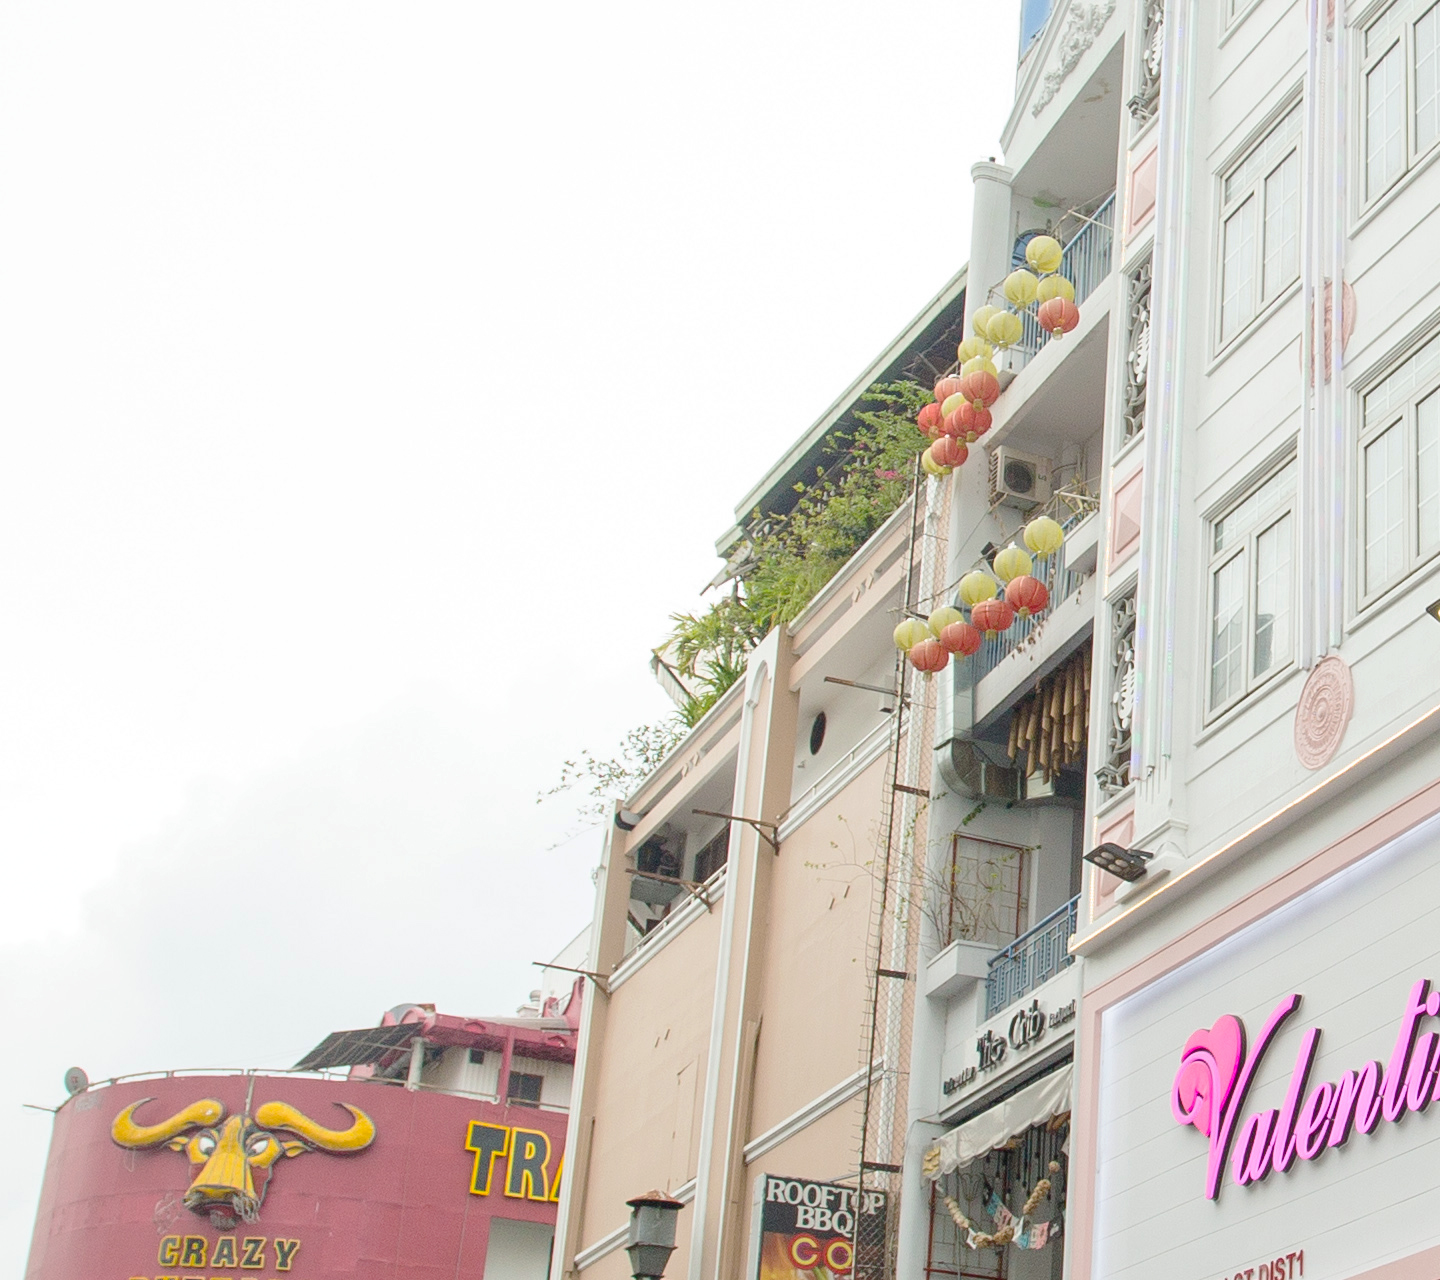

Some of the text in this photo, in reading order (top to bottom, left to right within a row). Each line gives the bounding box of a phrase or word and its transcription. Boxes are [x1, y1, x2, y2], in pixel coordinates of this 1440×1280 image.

[766, 1178, 886, 1216] ROOFTOP
[795, 1205, 854, 1237] BBQ
[158, 1234, 301, 1272] CRAZY
